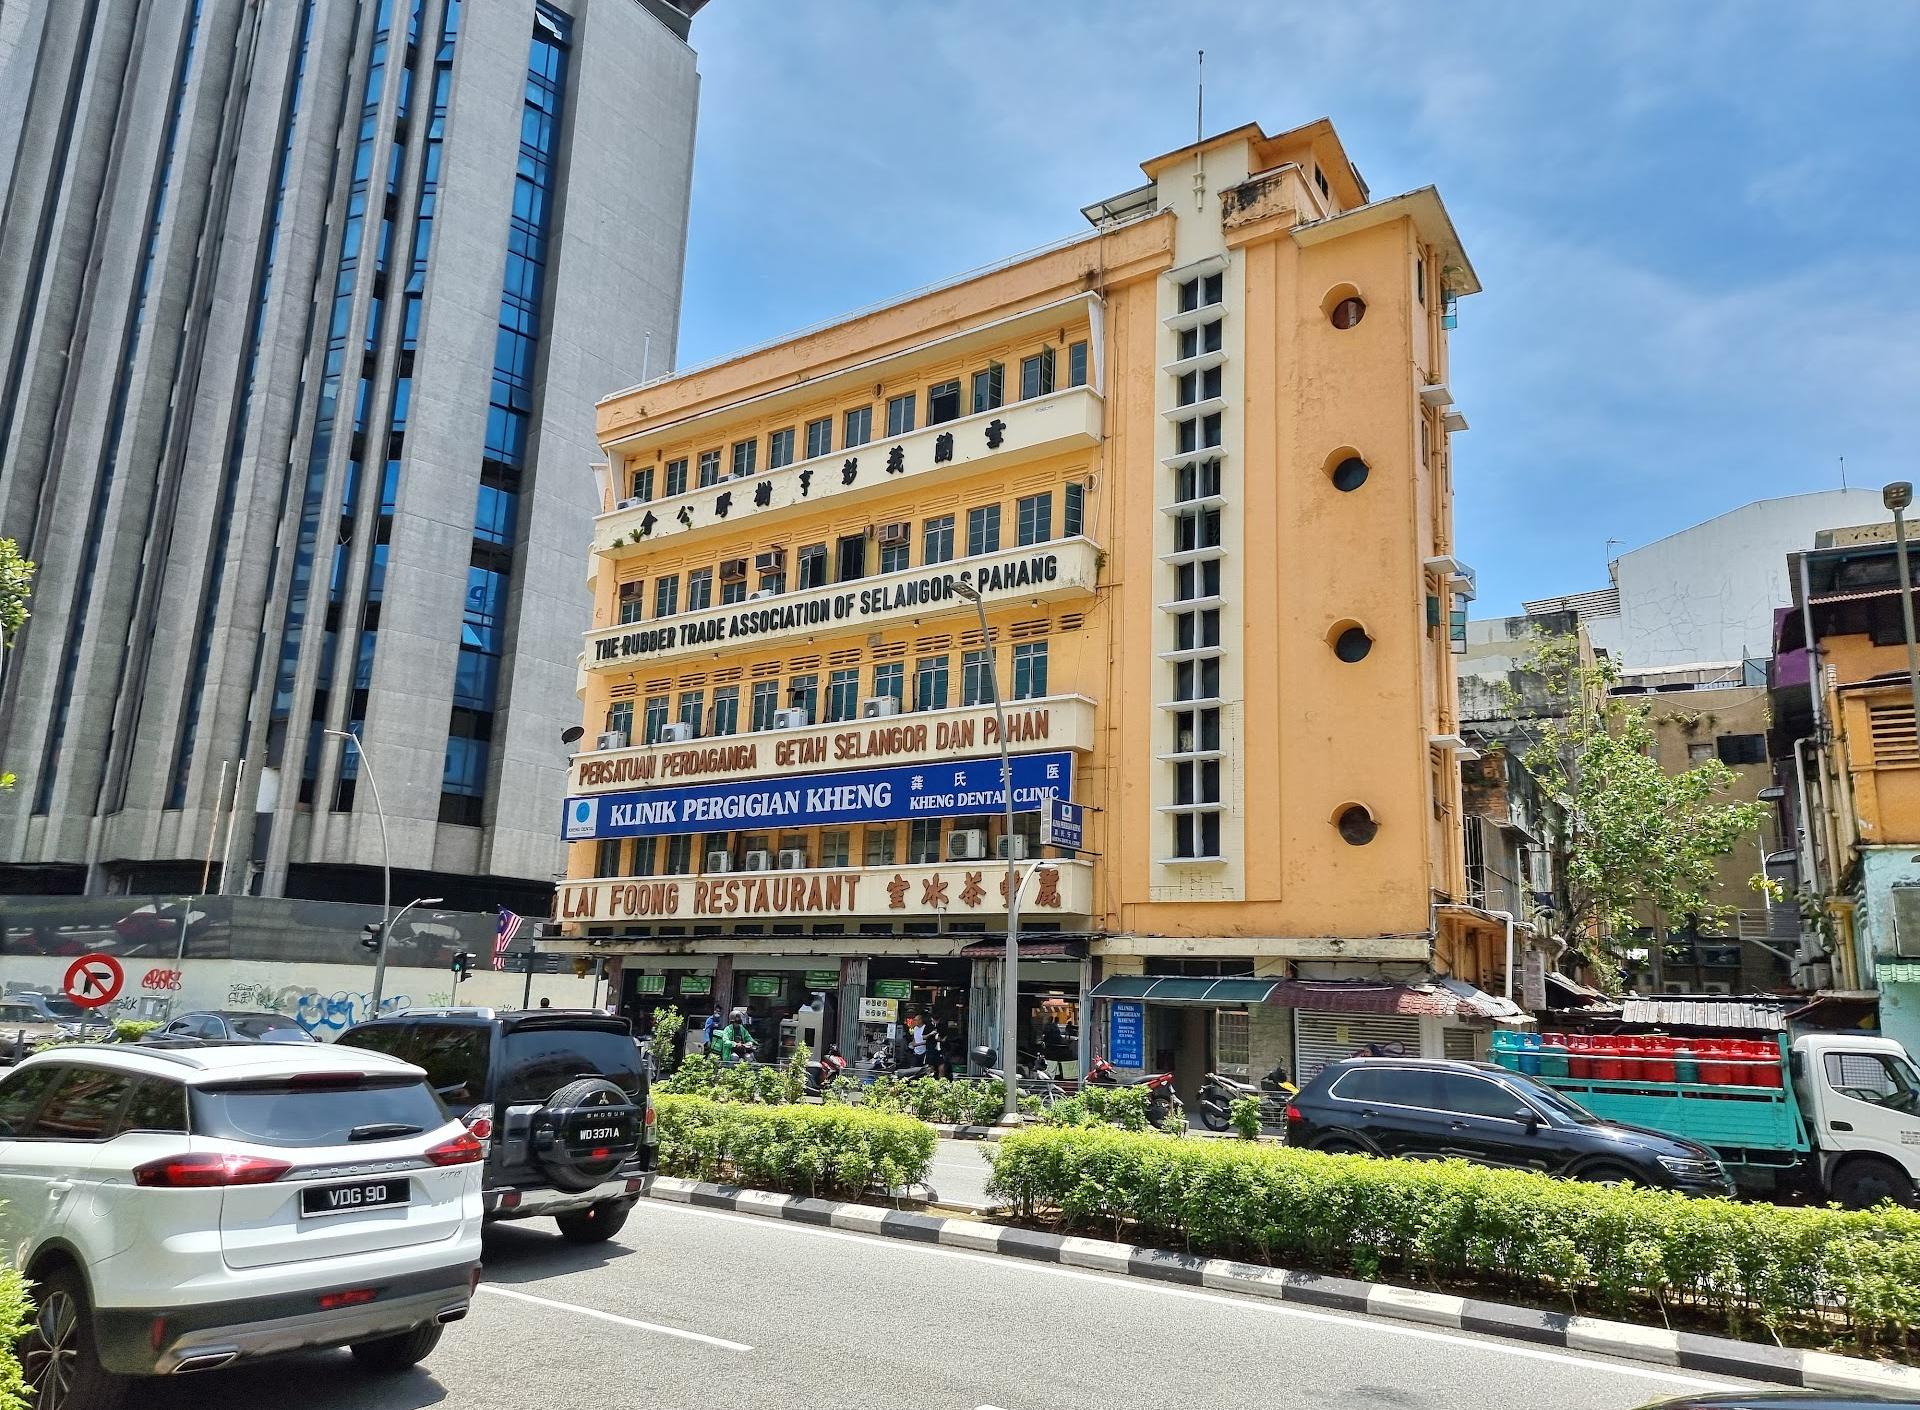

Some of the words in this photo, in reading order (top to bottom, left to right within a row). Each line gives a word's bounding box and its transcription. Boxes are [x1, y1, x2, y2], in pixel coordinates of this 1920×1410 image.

[595, 637, 620, 661] THE
[621, 627, 677, 657] RUBBER
[680, 617, 726, 646] TRADE
[729, 598, 830, 639] ASSOCIATION
[834, 593, 856, 620] OF
[860, 574, 954, 615] SELANGOR
[978, 555, 1057, 593] PAHANG
[578, 754, 657, 786] PERSATUAN
[660, 744, 757, 777] PERDAGANGA
[775, 736, 828, 766] GETAH
[834, 724, 928, 760] SELANGOR
[936, 719, 975, 750] DAN
[609, 800, 676, 827] KLINIK
[682, 790, 800, 822] PERGIGIAN
[805, 782, 892, 812] KHENG
[909, 794, 954, 810] KHENG
[957, 790, 1007, 807] DENTAL
[1013, 786, 1059, 801] CLINIC
[563, 886, 598, 918] LAI
[609, 882, 679, 916] FOONG
[693, 874, 861, 914] RESTAURANT
[311, 1160, 411, 1176] PROTON
[329, 1187, 361, 1206] VDG
[365, 1185, 387, 1202] 90
